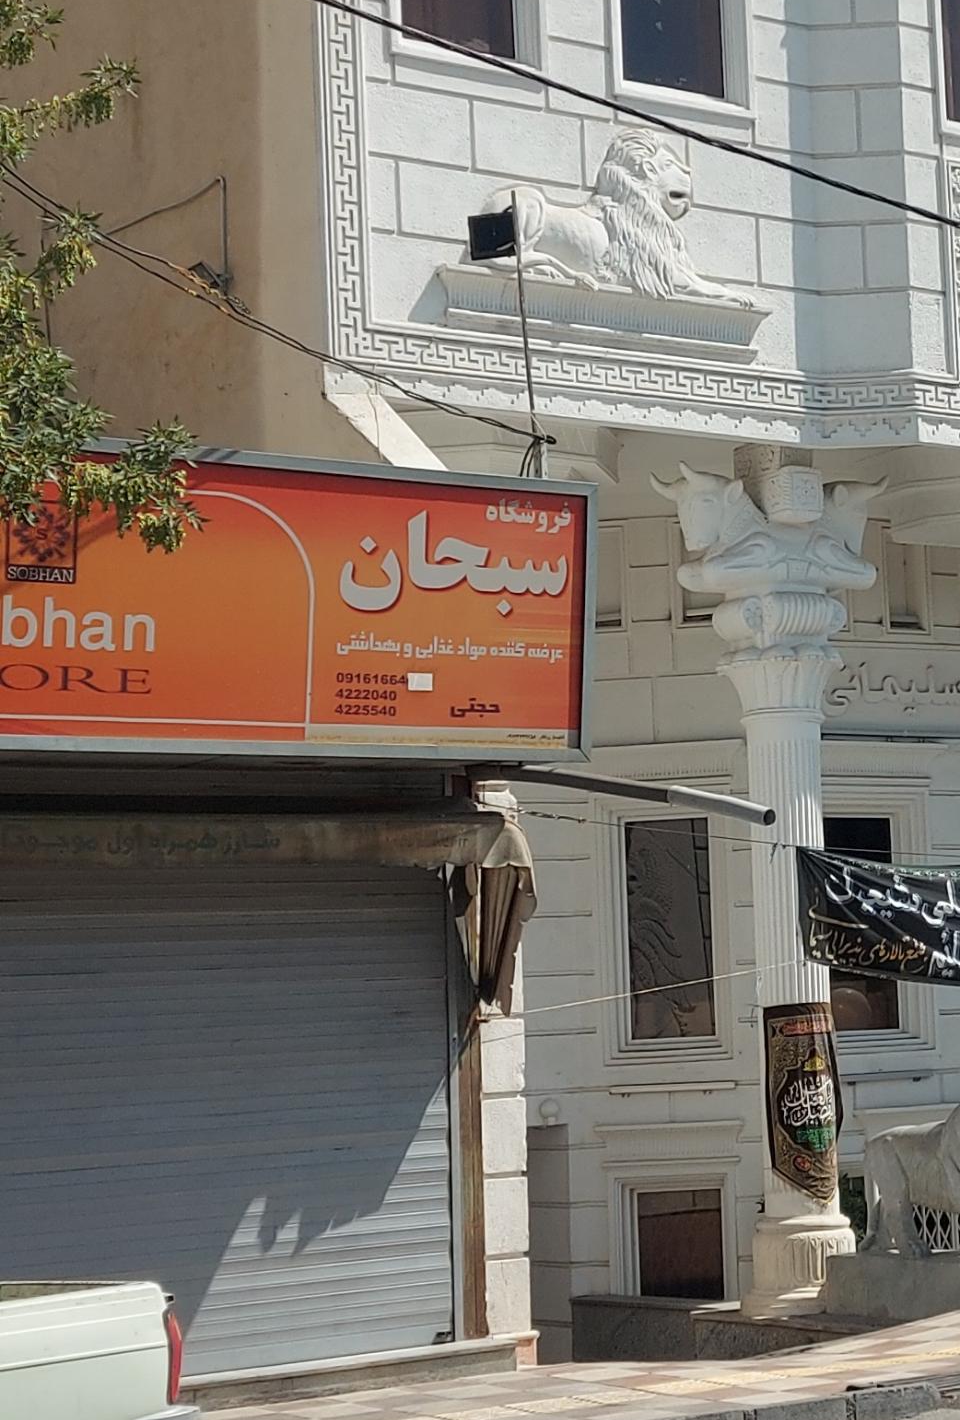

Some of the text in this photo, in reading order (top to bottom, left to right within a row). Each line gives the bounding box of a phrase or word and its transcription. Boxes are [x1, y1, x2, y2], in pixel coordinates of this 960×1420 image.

[485, 499, 572, 533] فروشگاه
[339, 510, 568, 617] سبحان
[7, 566, 74, 582] SOBHAN
[2, 595, 155, 652] bhan
[336, 630, 401, 658] بهداشتی
[403, 642, 413, 658] و
[457, 637, 487, 660] مواد
[490, 639, 525, 658] کننده
[527, 643, 563, 663] عرضه
[0, 663, 152, 694] ORE
[336, 672, 408, 686] 09161664
[335, 688, 397, 701] 4222040
[335, 704, 397, 717] 4225540
[450, 697, 501, 718] حجتی
